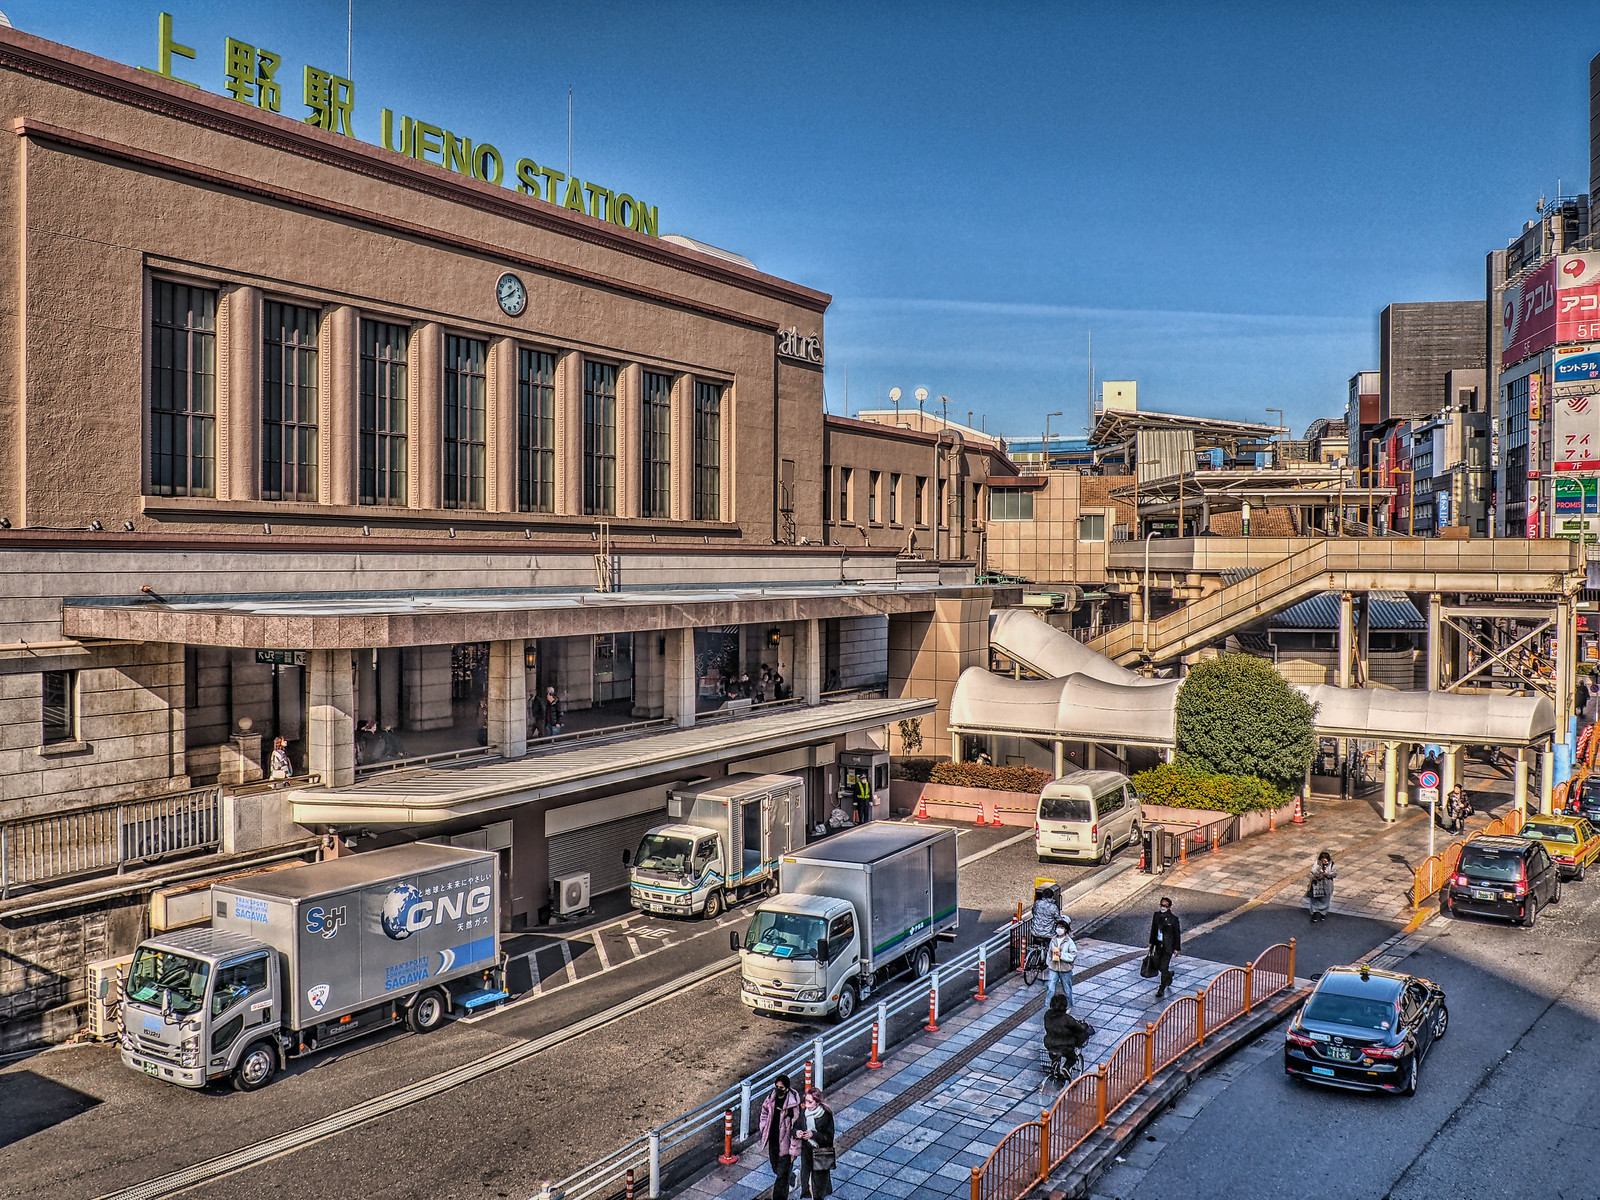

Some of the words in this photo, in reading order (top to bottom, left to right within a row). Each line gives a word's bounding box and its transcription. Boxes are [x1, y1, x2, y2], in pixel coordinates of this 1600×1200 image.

[137, 12, 355, 139] 上野駅
[381, 108, 504, 187] UENO
[515, 158, 659, 239] STATION
[1525, 280, 1555, 322] アコム
[1561, 294, 1600, 313] アコ
[1559, 362, 1597, 373] セントラル
[1556, 501, 1583, 509] PROMIS
[235, 908, 269, 924] SAGAWA
[406, 885, 491, 933] CNG
[385, 968, 429, 991] SAGAWA
